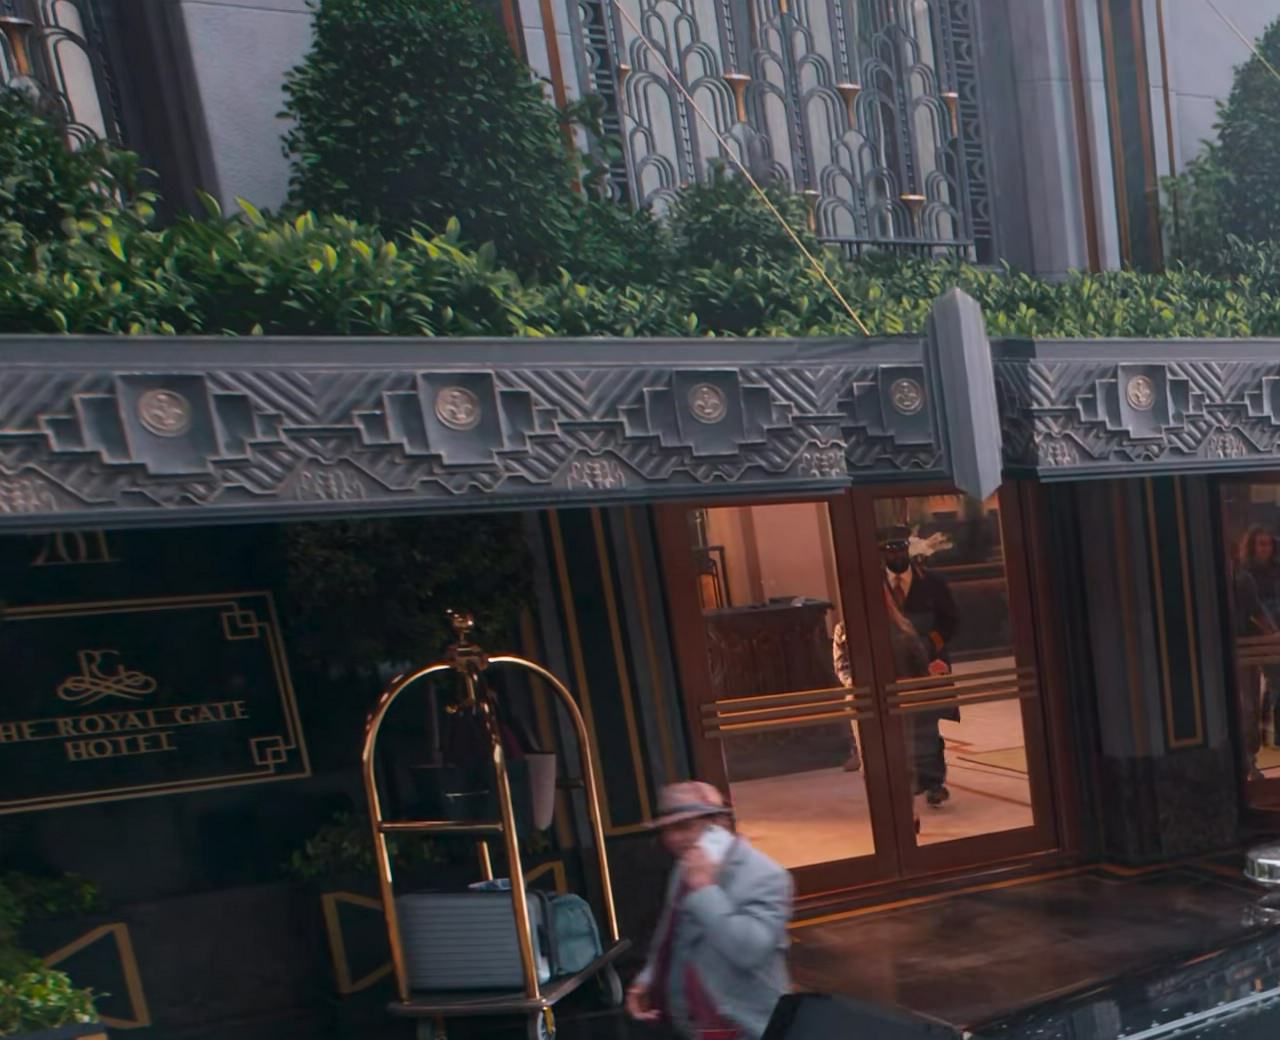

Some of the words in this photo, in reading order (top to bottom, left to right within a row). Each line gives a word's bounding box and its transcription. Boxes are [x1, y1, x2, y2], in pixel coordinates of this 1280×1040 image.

[0, 720, 37, 743] HE
[57, 709, 157, 737] ROYAL
[174, 700, 250, 725] GATE
[65, 732, 177, 761] HOTEL
